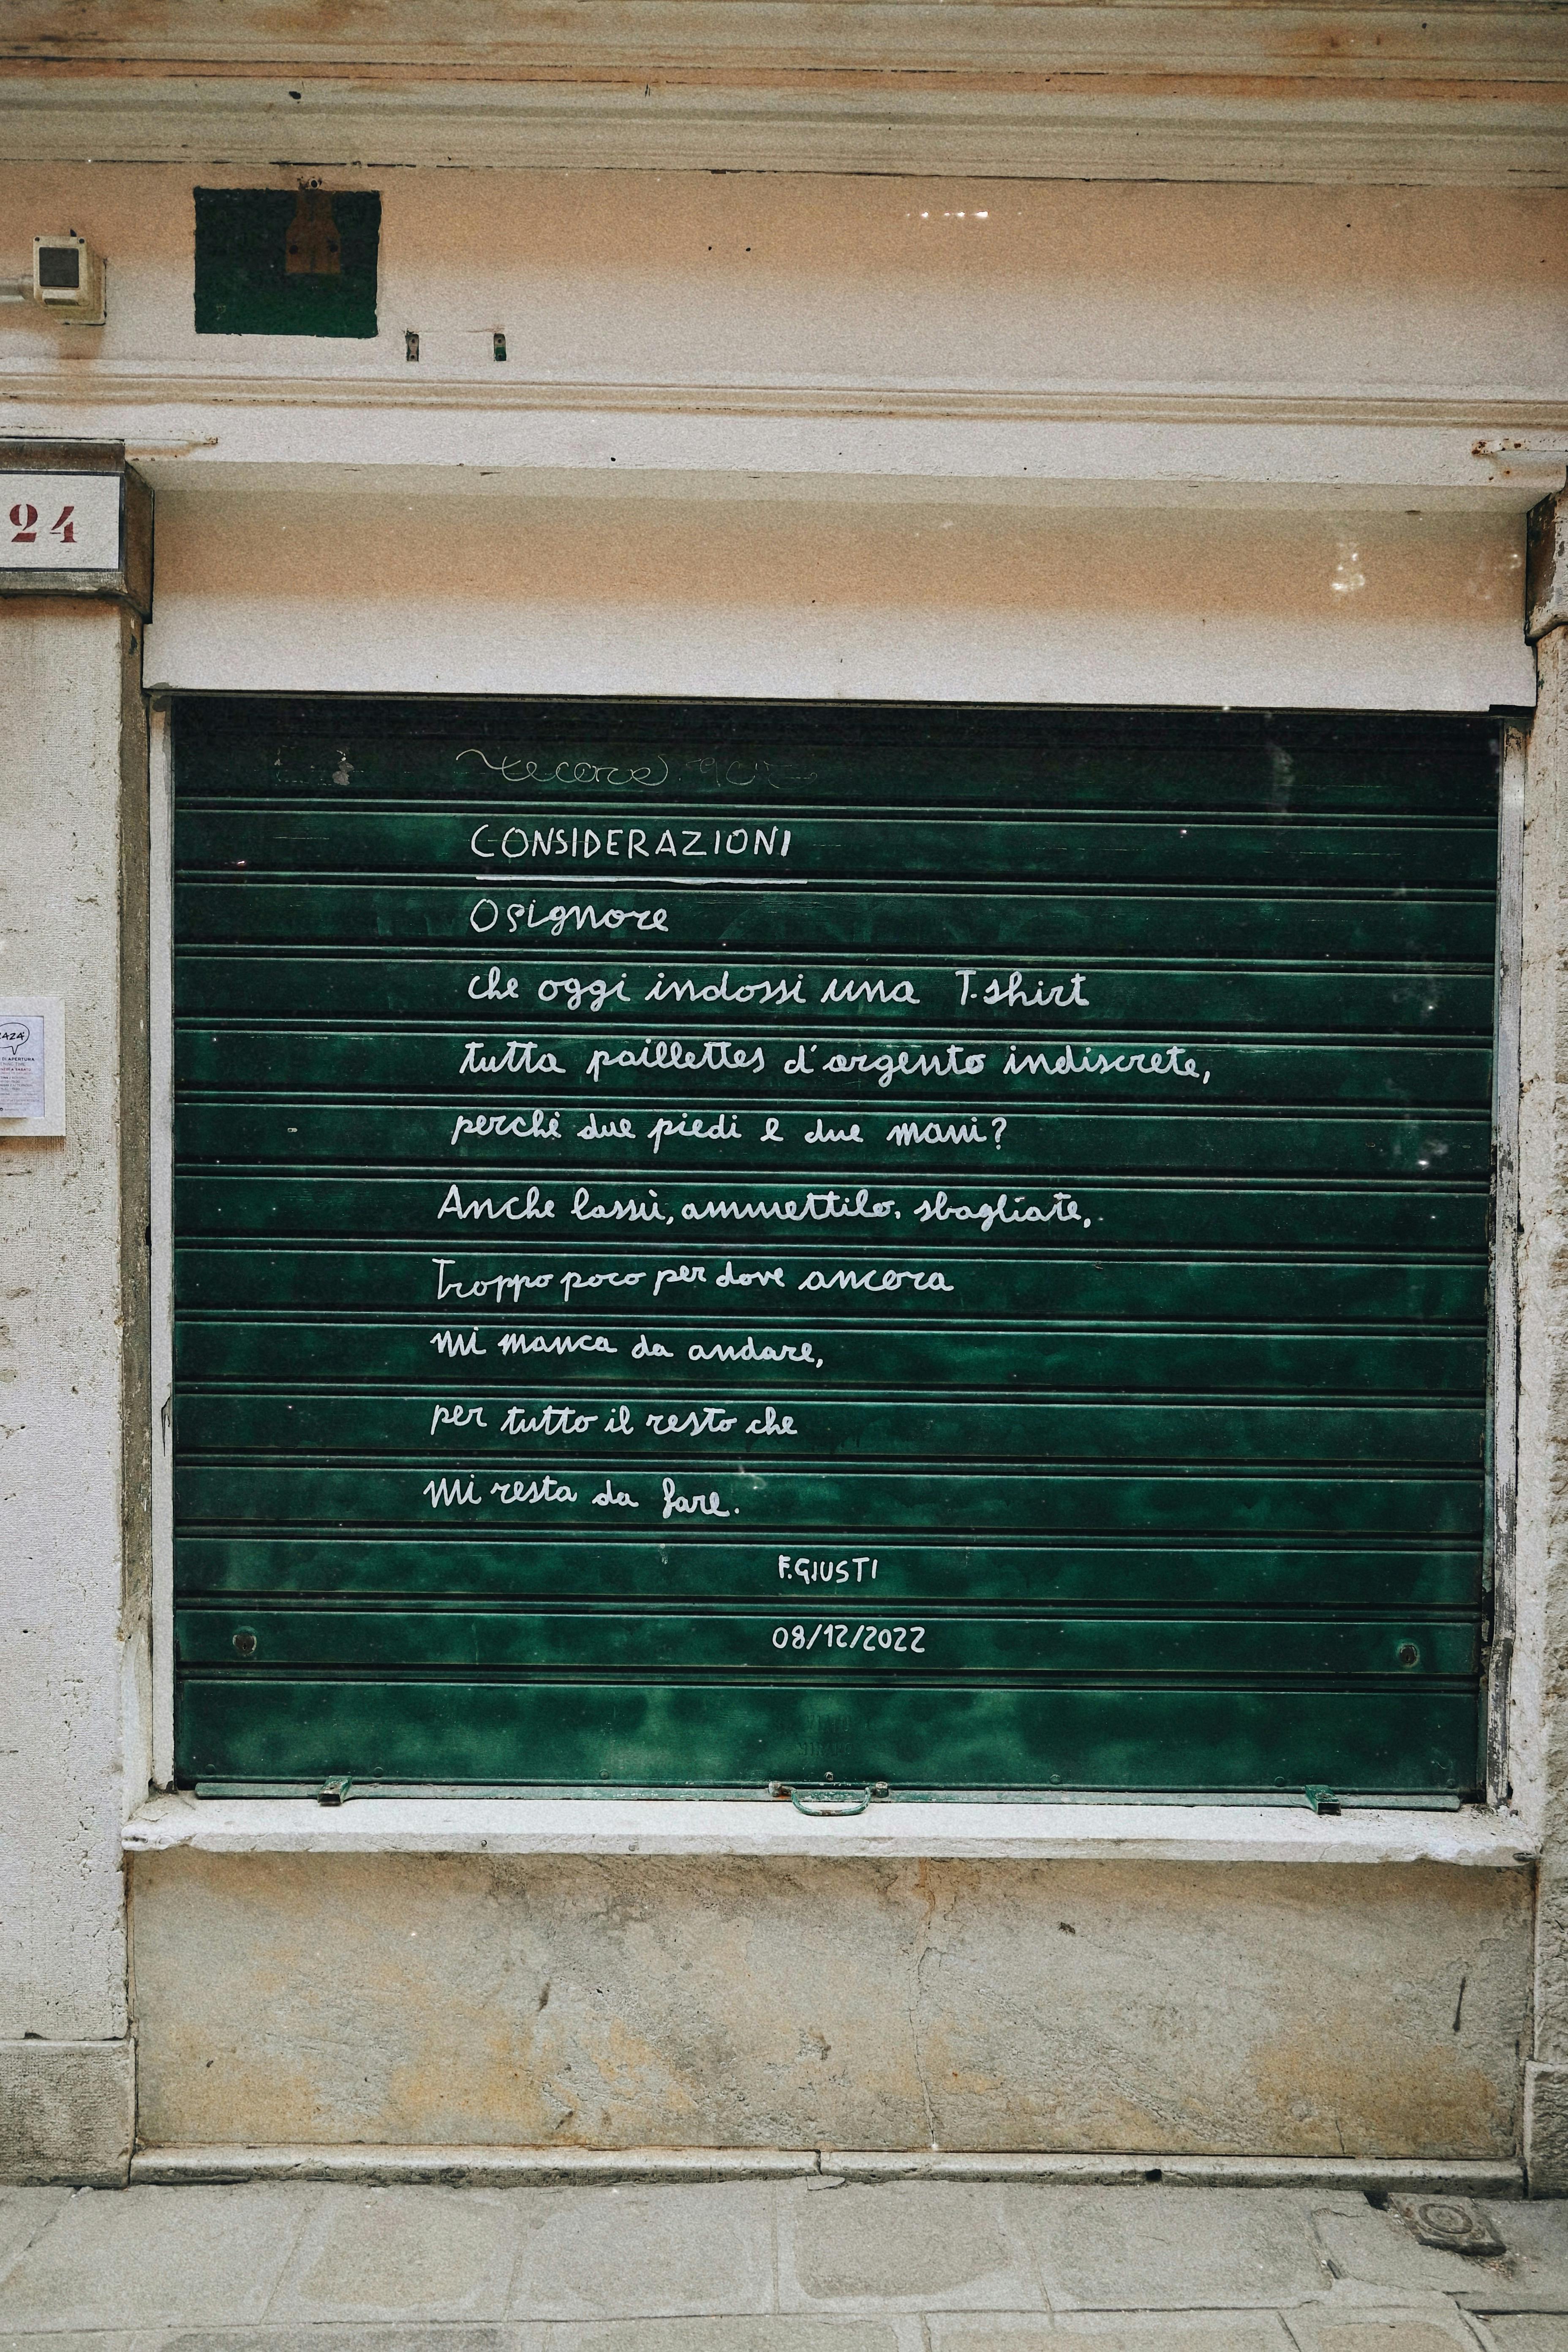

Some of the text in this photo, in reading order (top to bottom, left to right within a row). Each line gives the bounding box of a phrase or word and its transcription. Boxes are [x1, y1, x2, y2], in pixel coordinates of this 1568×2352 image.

[9, 503, 77, 543] 24
[471, 824, 791, 858] CONSIDERAZIONI
[467, 966, 519, 1000] che
[537, 972, 631, 1012] oggi
[644, 970, 806, 1005] indossi
[820, 978, 920, 1004] una
[459, 1040, 566, 1074] tutta
[585, 1037, 765, 1083] paillettes
[1002, 1045, 1210, 1084] indiscrete,
[576, 1113, 636, 1140] due
[647, 1113, 742, 1154] piedi
[760, 1117, 784, 1142] e
[804, 1118, 864, 1144] due
[885, 1116, 1007, 1151] mani?
[437, 1184, 555, 1220] Anche
[431, 1258, 955, 1303] Troppo poco per dove ancora
[497, 1333, 618, 1356] manca
[631, 1334, 674, 1359] da
[688, 1336, 824, 1369] andare,
[430, 1404, 798, 1437] per tutto il resto che
[490, 1475, 578, 1504] resta
[591, 1479, 640, 1508] da
[662, 1477, 740, 1519] fare.
[772, 1623, 926, 1653] 08/12/2022
